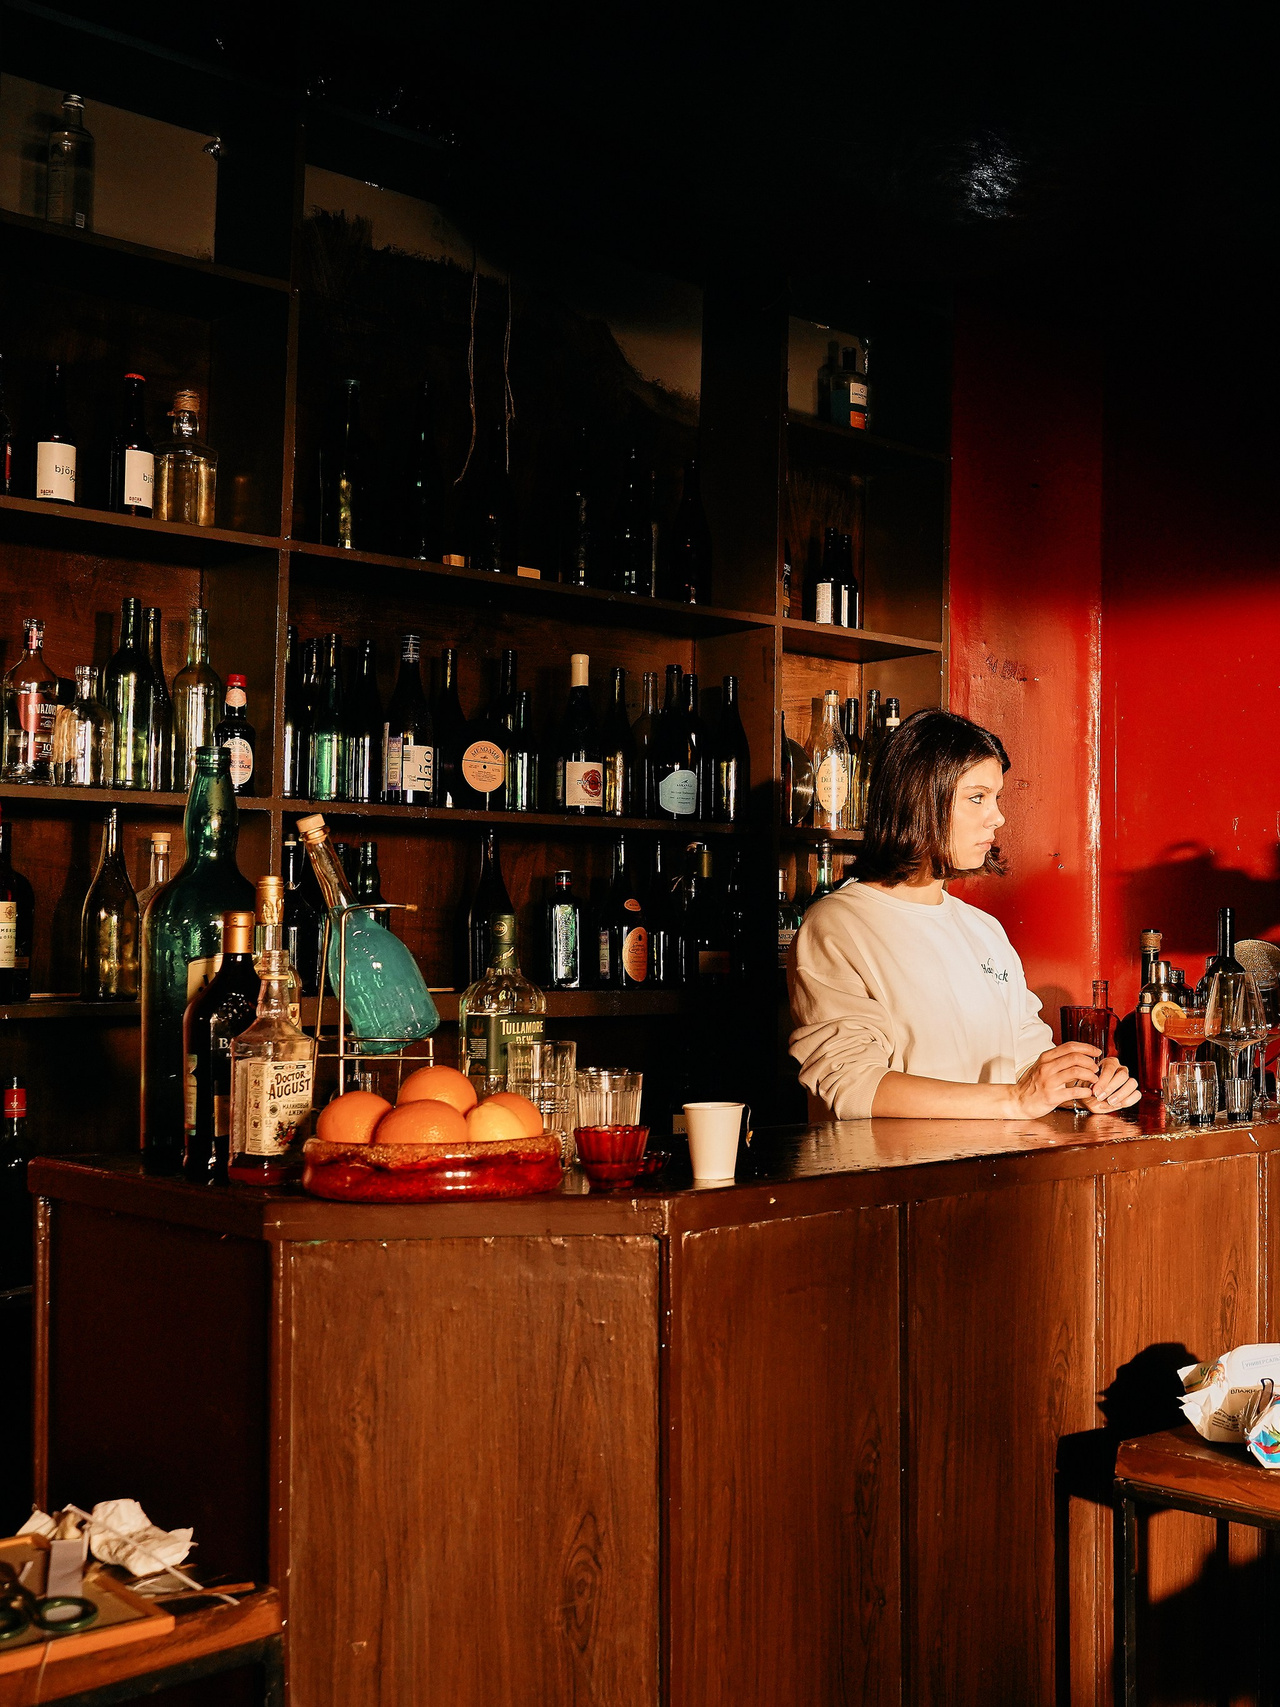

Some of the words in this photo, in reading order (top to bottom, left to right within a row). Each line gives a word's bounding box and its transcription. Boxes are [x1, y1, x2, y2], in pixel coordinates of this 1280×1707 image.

[417, 749, 433, 791] dão
[499, 1018, 544, 1036] TULLAMORE
[275, 1070, 306, 1086] DOCTOR
[267, 1078, 311, 1101] AUGUST
